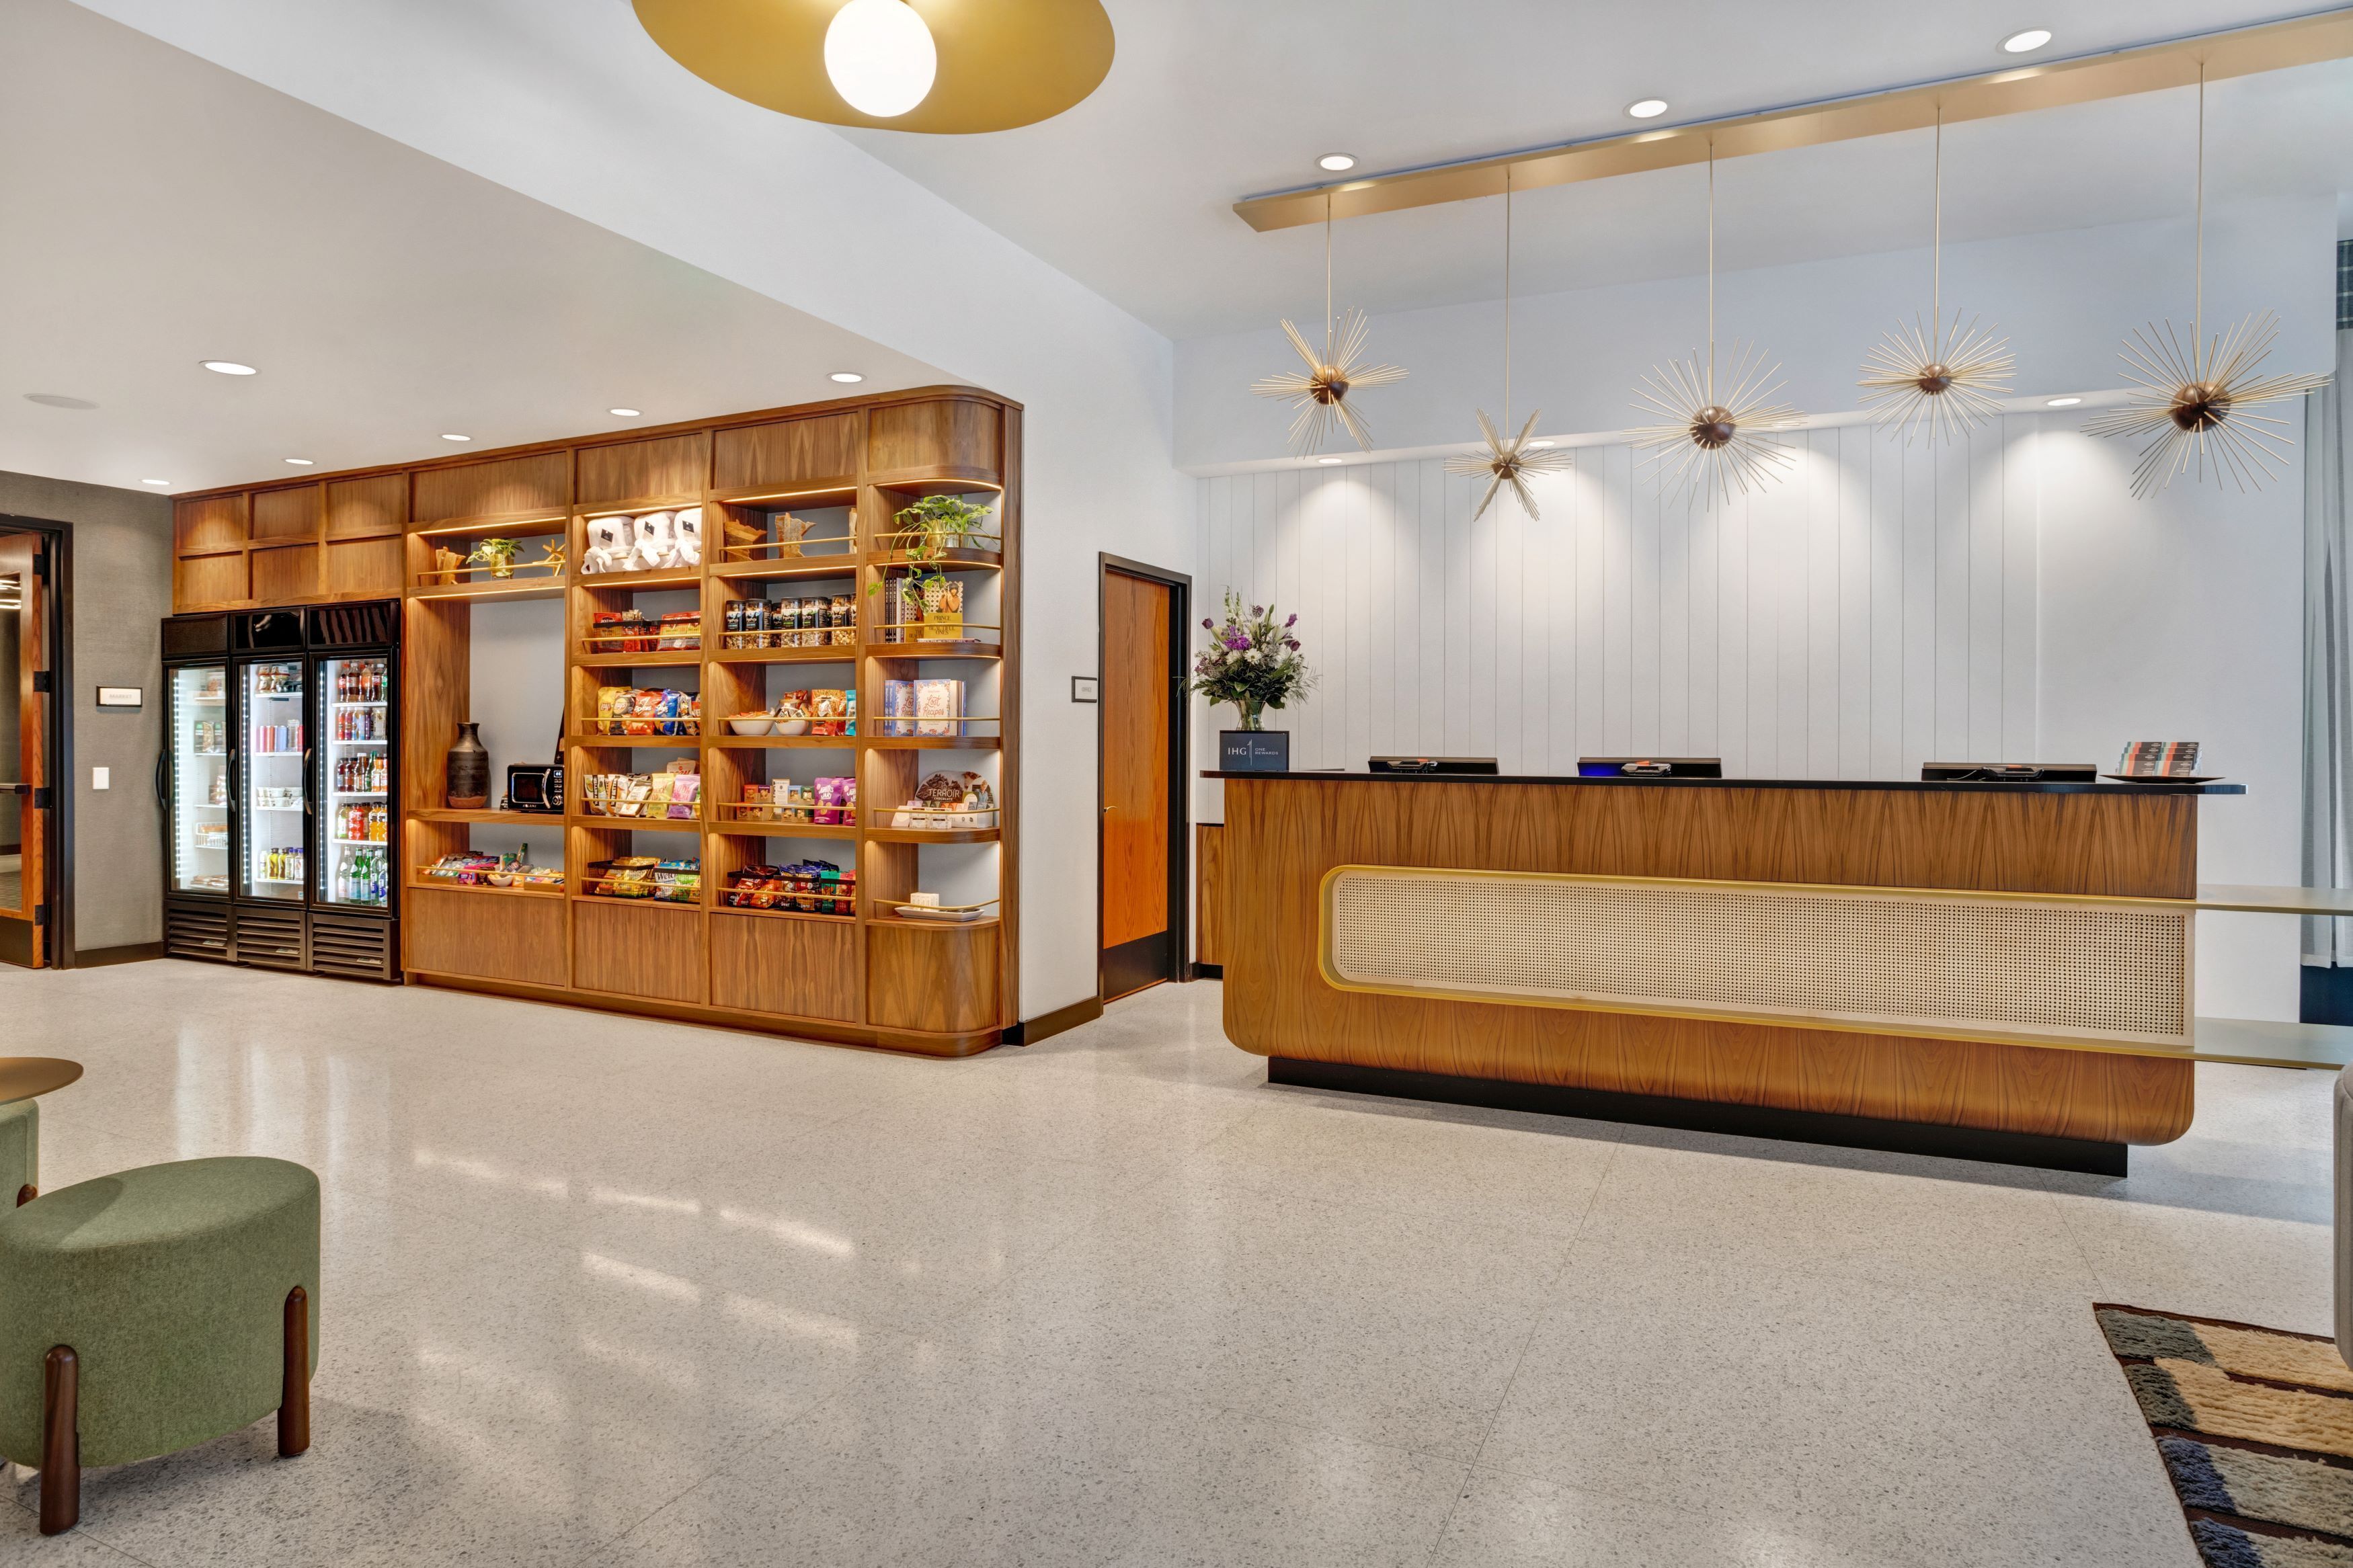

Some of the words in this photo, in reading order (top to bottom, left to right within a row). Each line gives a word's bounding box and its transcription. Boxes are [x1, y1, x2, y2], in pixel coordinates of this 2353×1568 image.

[925, 694, 941, 708] Lost
[923, 706, 944, 717] Recipes
[1228, 747, 1246, 755] IHG
[928, 788, 960, 798] TERROIR
